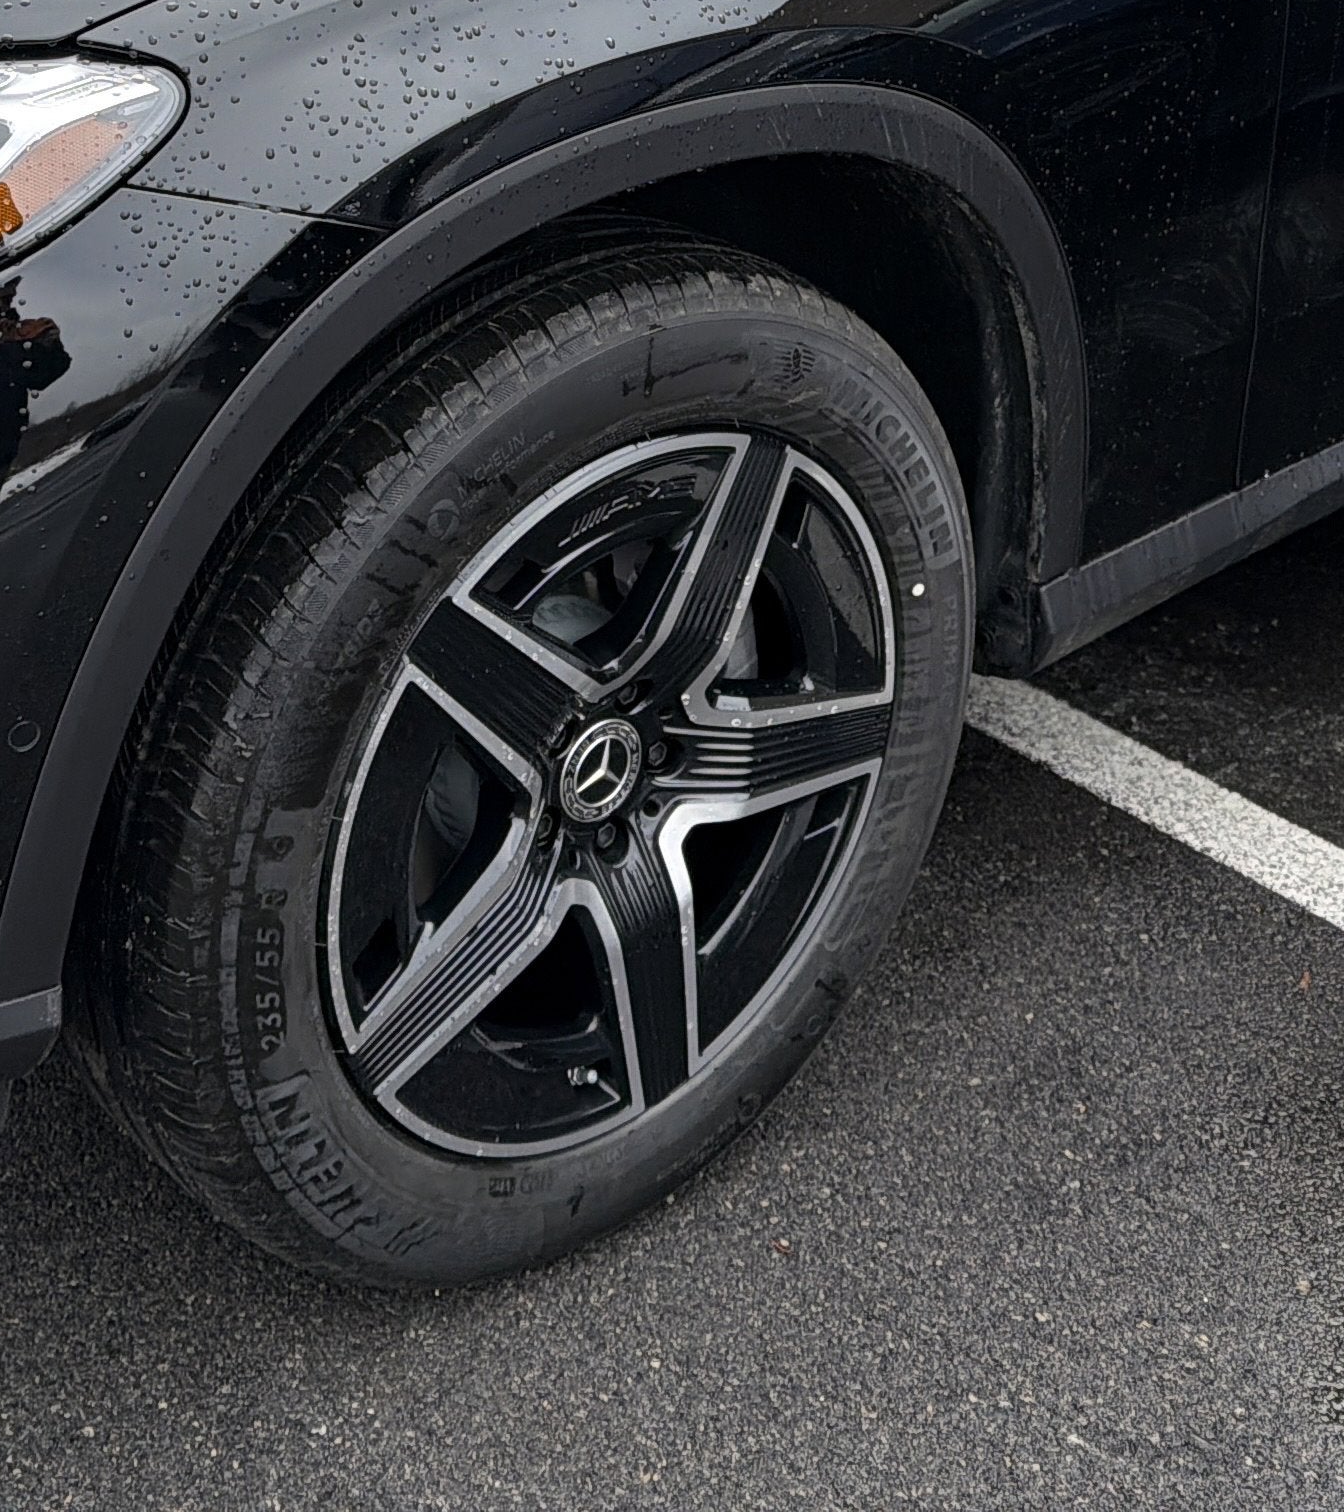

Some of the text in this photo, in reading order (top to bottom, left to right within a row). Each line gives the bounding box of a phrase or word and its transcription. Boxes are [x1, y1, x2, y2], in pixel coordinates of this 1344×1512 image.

[456, 429, 527, 501] MCHELIN
[830, 377, 954, 557] MICHELIN
[255, 926, 286, 1052] 235/55
